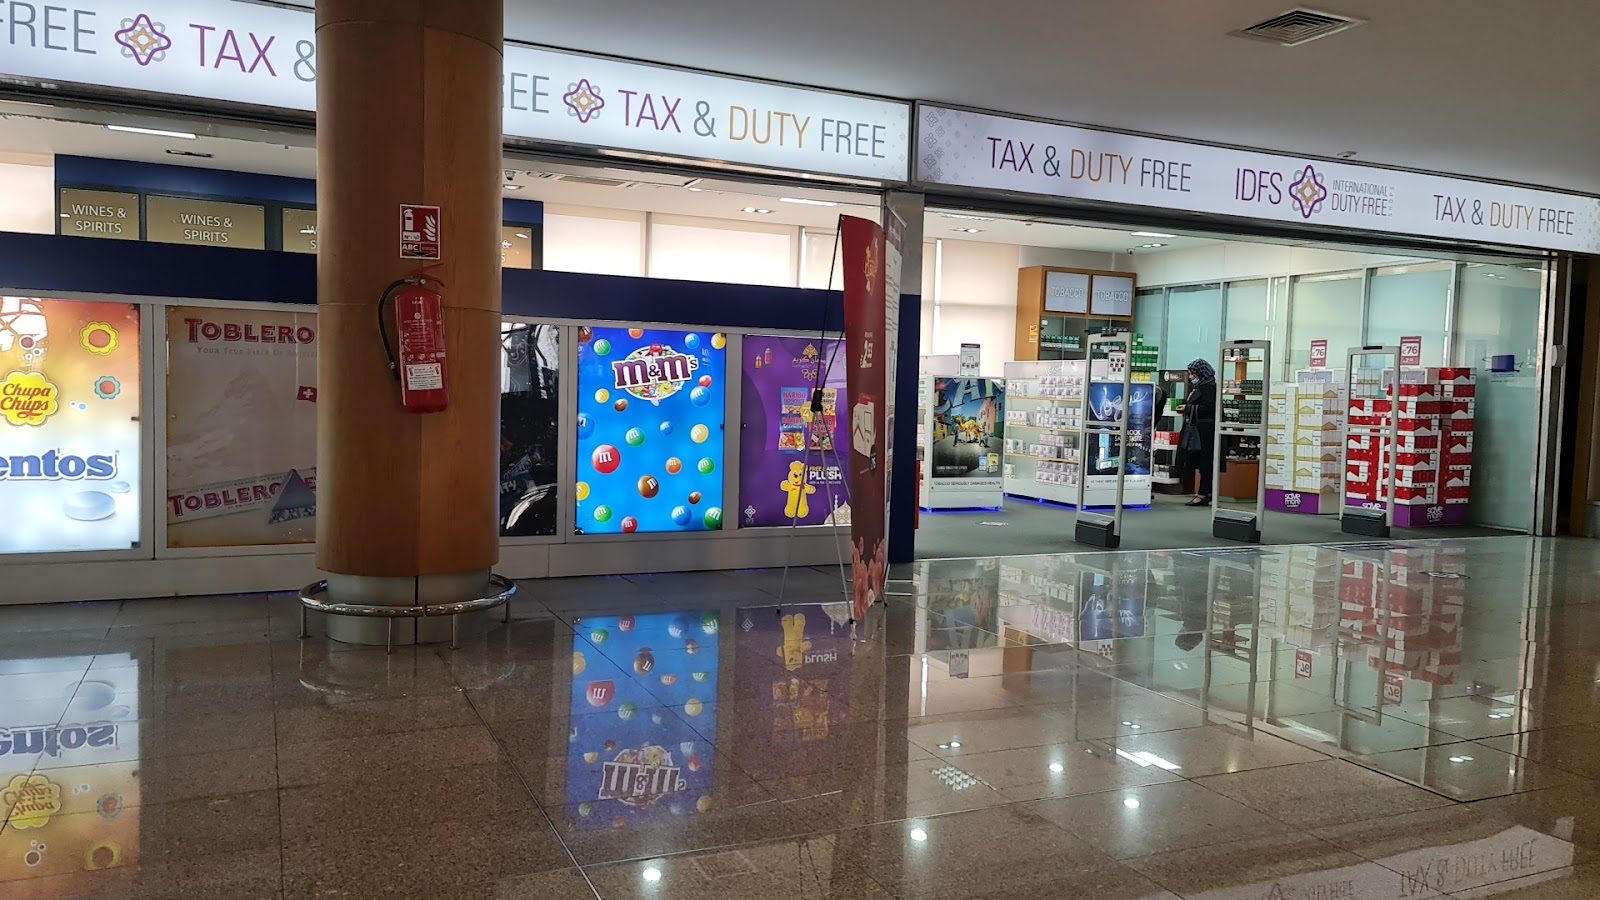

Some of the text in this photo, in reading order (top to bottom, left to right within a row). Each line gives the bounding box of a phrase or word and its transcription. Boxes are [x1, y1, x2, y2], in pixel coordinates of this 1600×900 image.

[0, 0, 97, 54] REE
[189, 24, 316, 82] TAX &
[618, 89, 887, 160] TAX & DUTY FREE
[986, 136, 1192, 192] TAX & DUTY FREE
[1235, 167, 1284, 205] IDFS
[1332, 180, 1388, 197] INTERNATIONAL
[72, 204, 127, 218] WINES &
[1331, 193, 1388, 217] DUTY FREE
[181, 213, 233, 228] WINES &
[1433, 194, 1575, 236] TAX & DUTY FREE
[75, 220, 122, 234] SPIRITS
[184, 229, 228, 243] SPIRITS
[1050, 286, 1083, 298] TOBACCO
[1096, 290, 1128, 302] TOBACCO
[3, 383, 51, 401] Chupa
[0, 397, 49, 413] Chups
[810, 471, 842, 480] PLUSH
